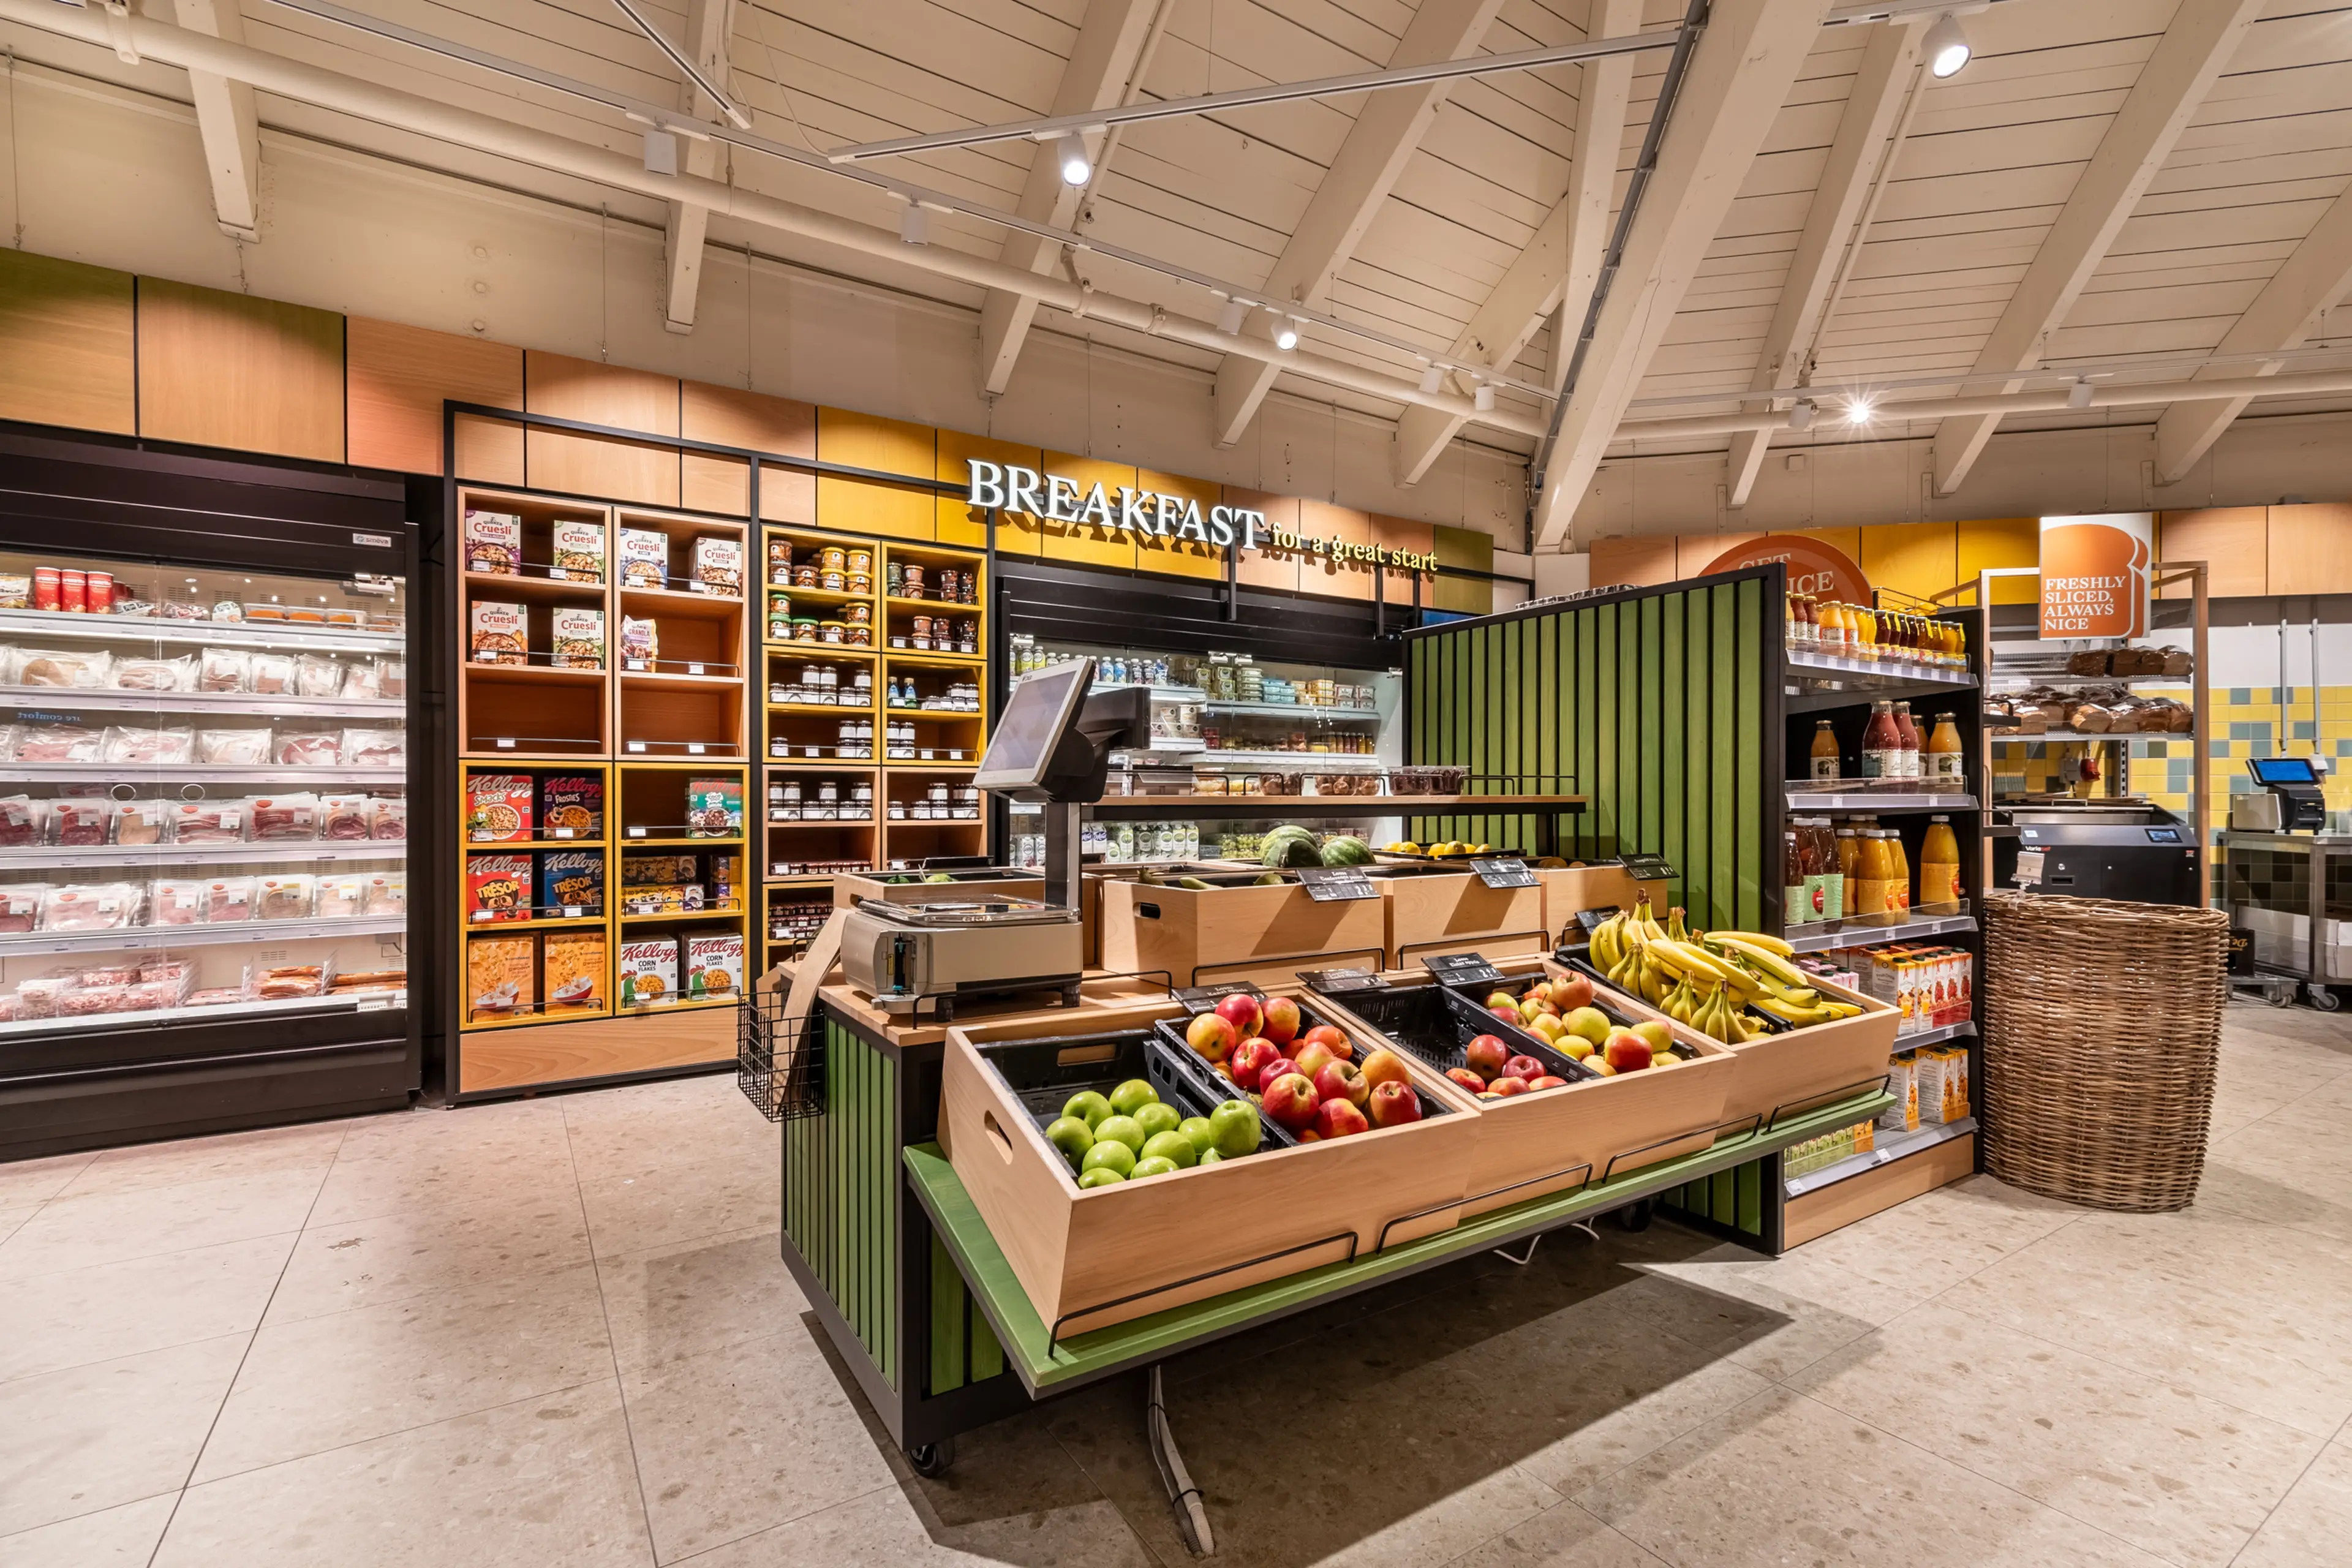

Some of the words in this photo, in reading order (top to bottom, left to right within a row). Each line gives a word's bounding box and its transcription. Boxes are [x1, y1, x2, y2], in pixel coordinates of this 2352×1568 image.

[965, 458, 1265, 550] BREAKFAST
[1272, 522, 1305, 549] for
[1312, 536, 1324, 554] a
[1332, 534, 1385, 563] great
[1392, 547, 1438, 571] start
[473, 522, 511, 535] Cruesli
[562, 532, 597, 545] Cruesli
[627, 540, 660, 552] Cruesli
[705, 549, 736, 560] Cruesli
[1788, 570, 1834, 598] ICE
[2045, 576, 2126, 590] FRESHLY
[2045, 590, 2114, 603] SLICED,
[2044, 603, 2114, 617] ALWAYS
[480, 612, 518, 624] Cruesli
[2045, 617, 2089, 630] NICE
[561, 619, 596, 631] Cruesli
[555, 793, 580, 804] FROSTIES
